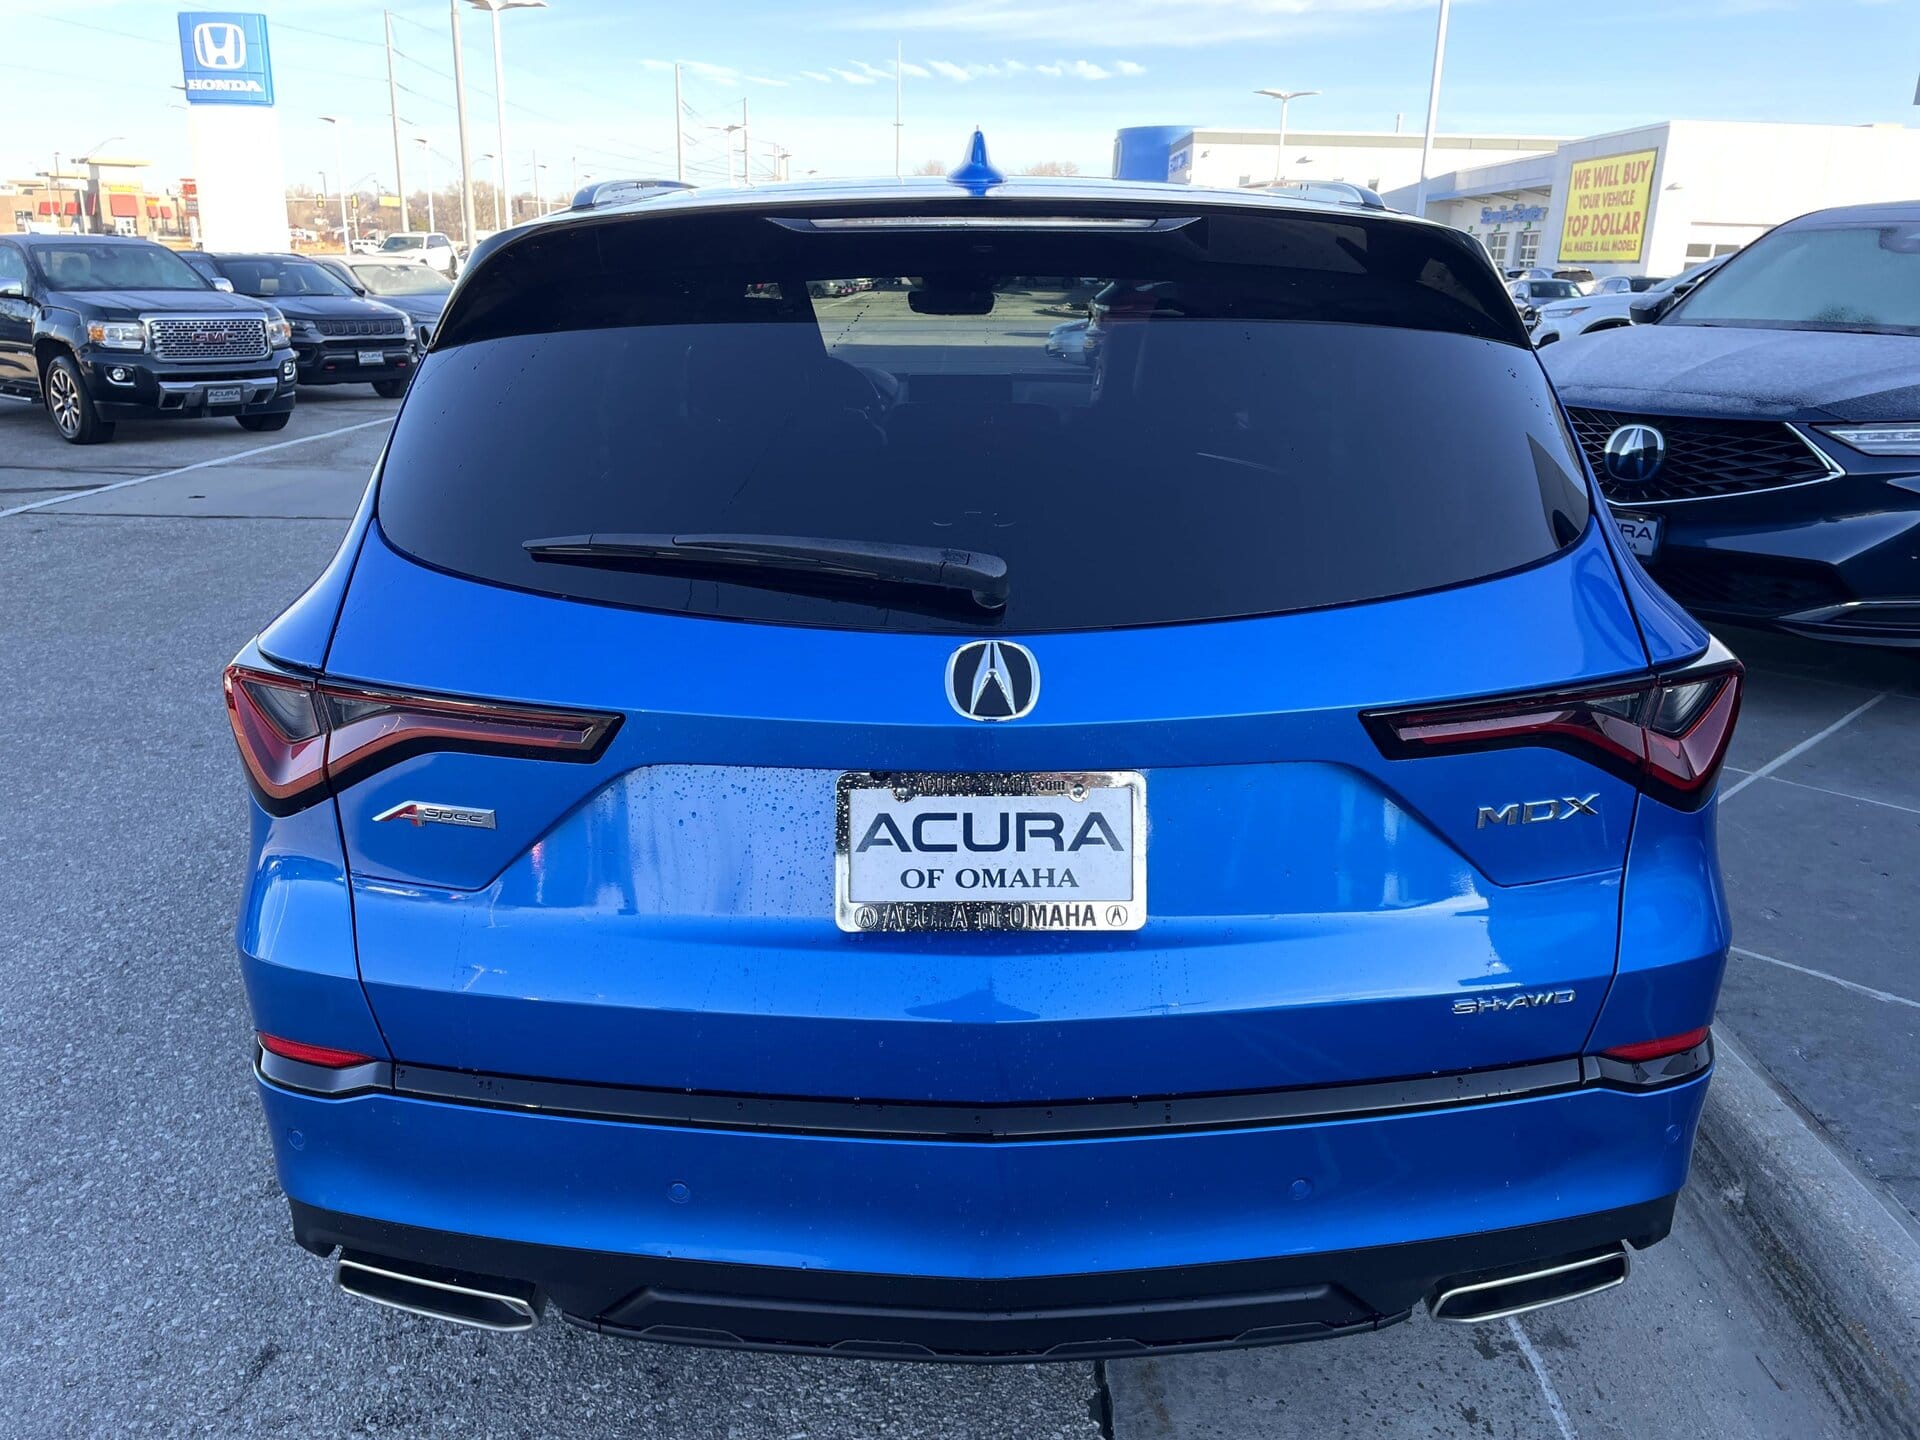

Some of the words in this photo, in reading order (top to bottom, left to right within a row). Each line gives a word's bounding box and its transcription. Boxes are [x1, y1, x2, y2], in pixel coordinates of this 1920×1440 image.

[187, 79, 264, 93] HONDA
[1574, 168, 1592, 190] WE
[1593, 164, 1619, 188] WILL
[1623, 160, 1651, 185] BUY
[1579, 193, 1600, 209] YOUR
[1602, 190, 1635, 207] VEHICLE
[1567, 214, 1589, 237] TOP
[1591, 211, 1641, 236] DOLLAR
[1563, 241, 1573, 253] ALL
[1574, 241, 1593, 252] MAKES
[1601, 240, 1610, 252] ALL
[1611, 240, 1637, 251] MODELS
[1476, 792, 1601, 829] MDX
[855, 812, 1124, 852] ACURA
[900, 868, 944, 889] OF
[955, 868, 1080, 889] OMAHA
[1010, 904, 1097, 928] OMAHA
[1451, 988, 1576, 1015] SH-AWD
